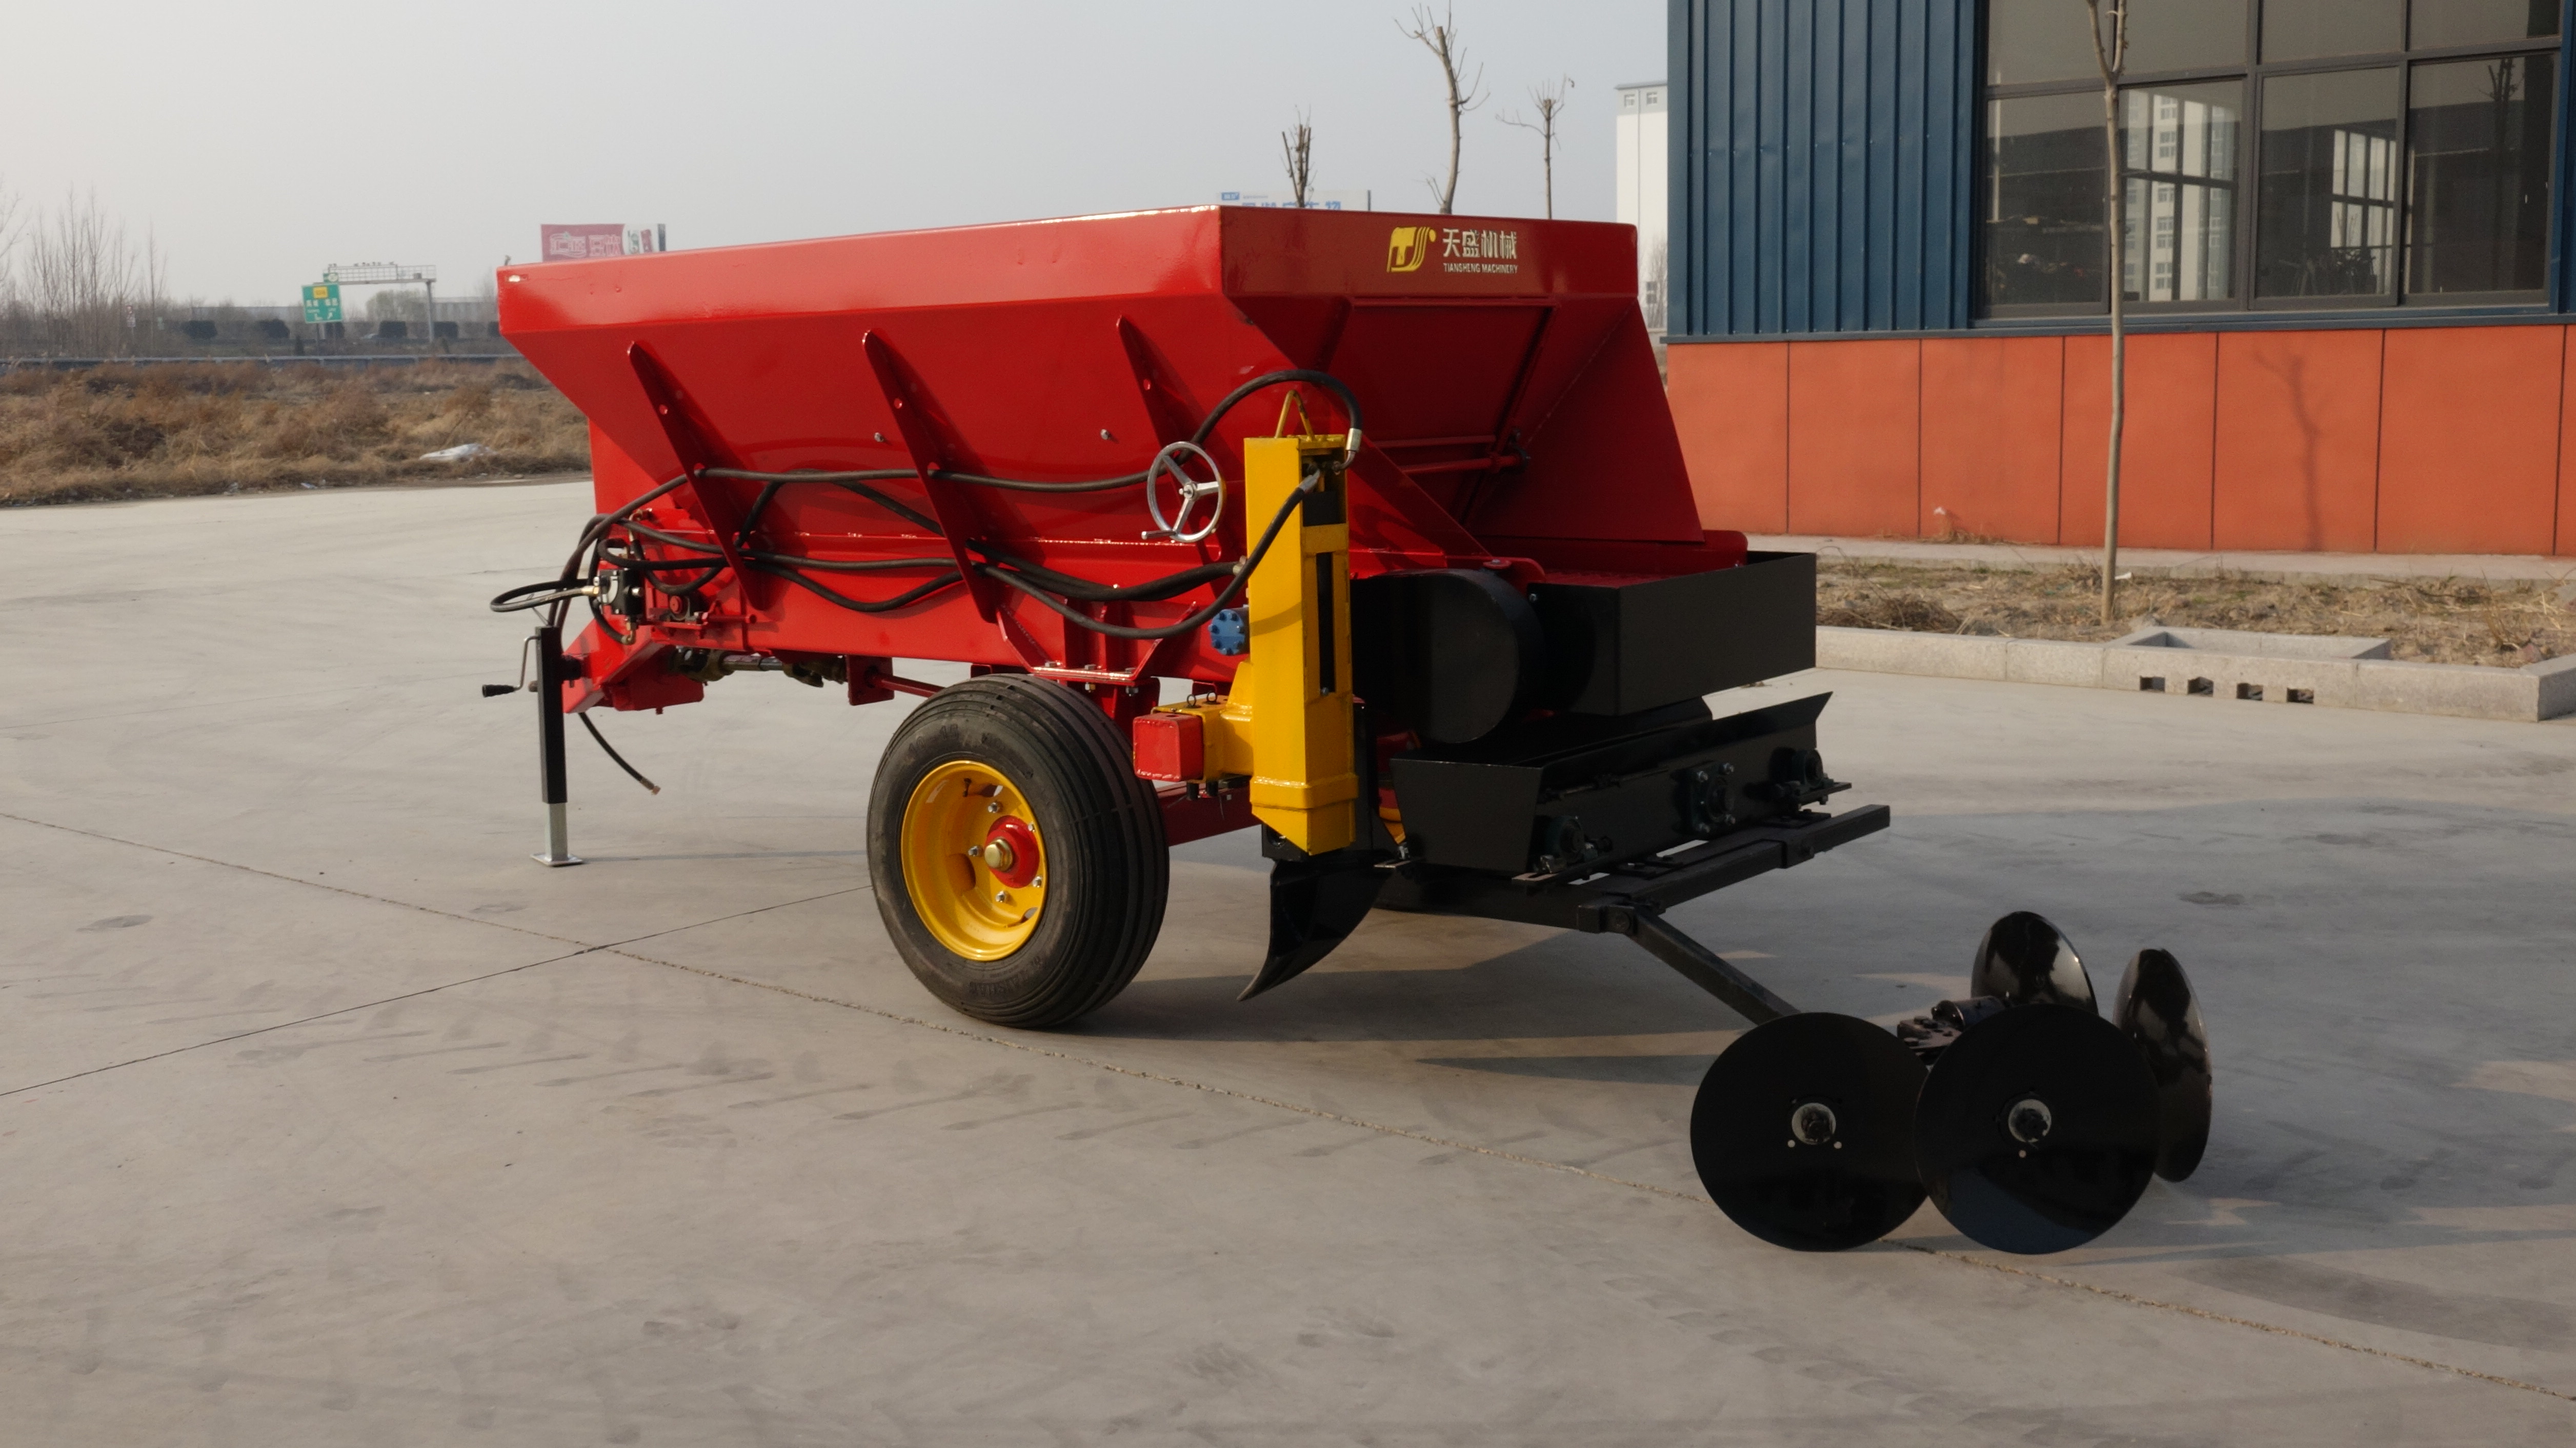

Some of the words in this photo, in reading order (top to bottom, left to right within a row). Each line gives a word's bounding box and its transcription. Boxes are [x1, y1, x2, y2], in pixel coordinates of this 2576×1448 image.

[1442, 228, 1517, 259] 天盛机械
[1443, 263, 1480, 273] TIANSHENG
[1481, 264, 1518, 274] MACHINERY
